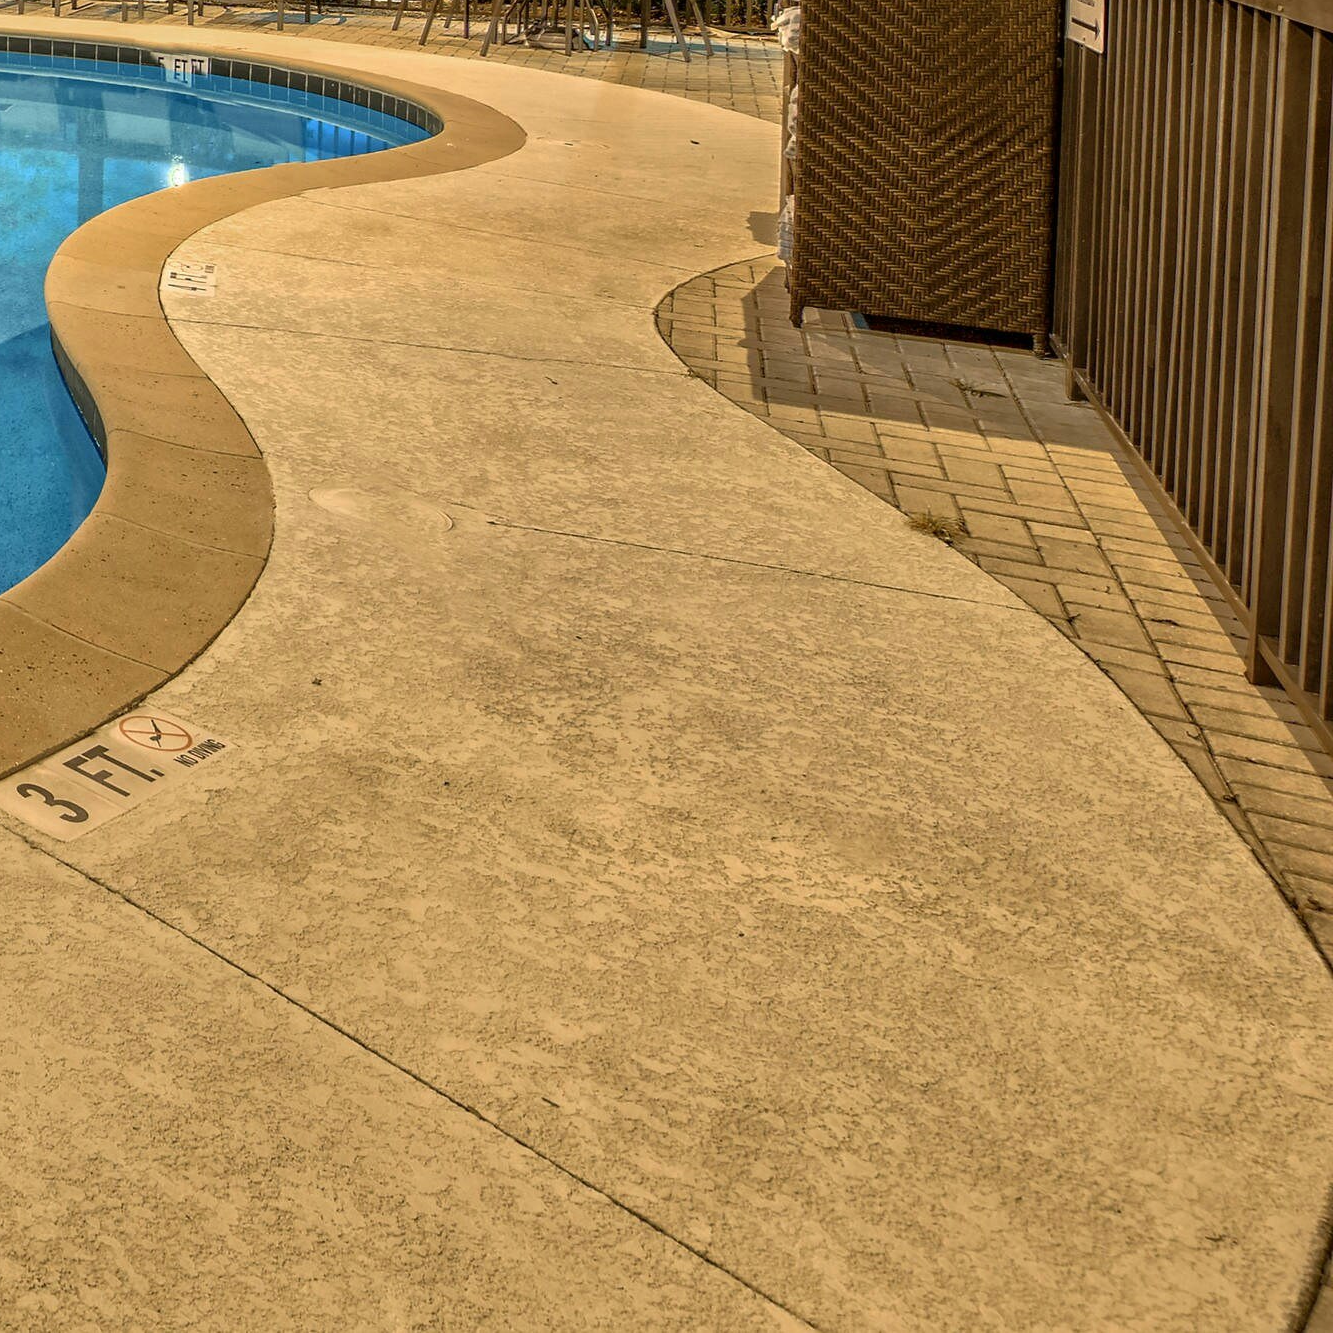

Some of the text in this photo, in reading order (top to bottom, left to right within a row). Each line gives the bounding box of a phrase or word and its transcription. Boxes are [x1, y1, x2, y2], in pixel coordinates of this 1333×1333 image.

[173, 738, 227, 768] NO DIVING
[16, 782, 90, 824] 3
